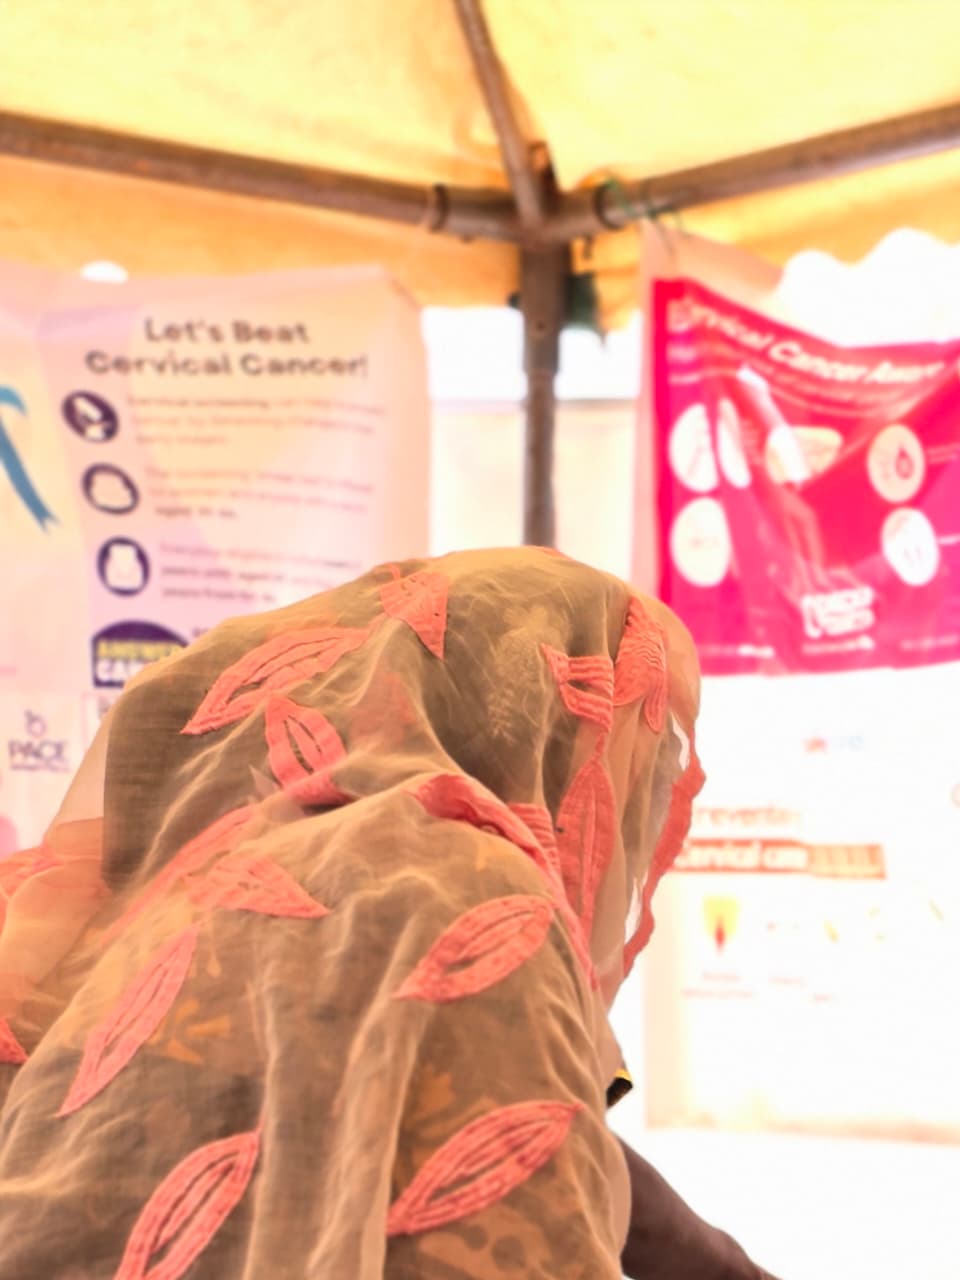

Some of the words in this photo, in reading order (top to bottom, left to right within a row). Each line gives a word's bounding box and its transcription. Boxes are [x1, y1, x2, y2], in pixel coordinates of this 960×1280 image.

[144, 317, 224, 343] Let's
[232, 320, 311, 344] Beat
[84, 350, 232, 376] Cervical
